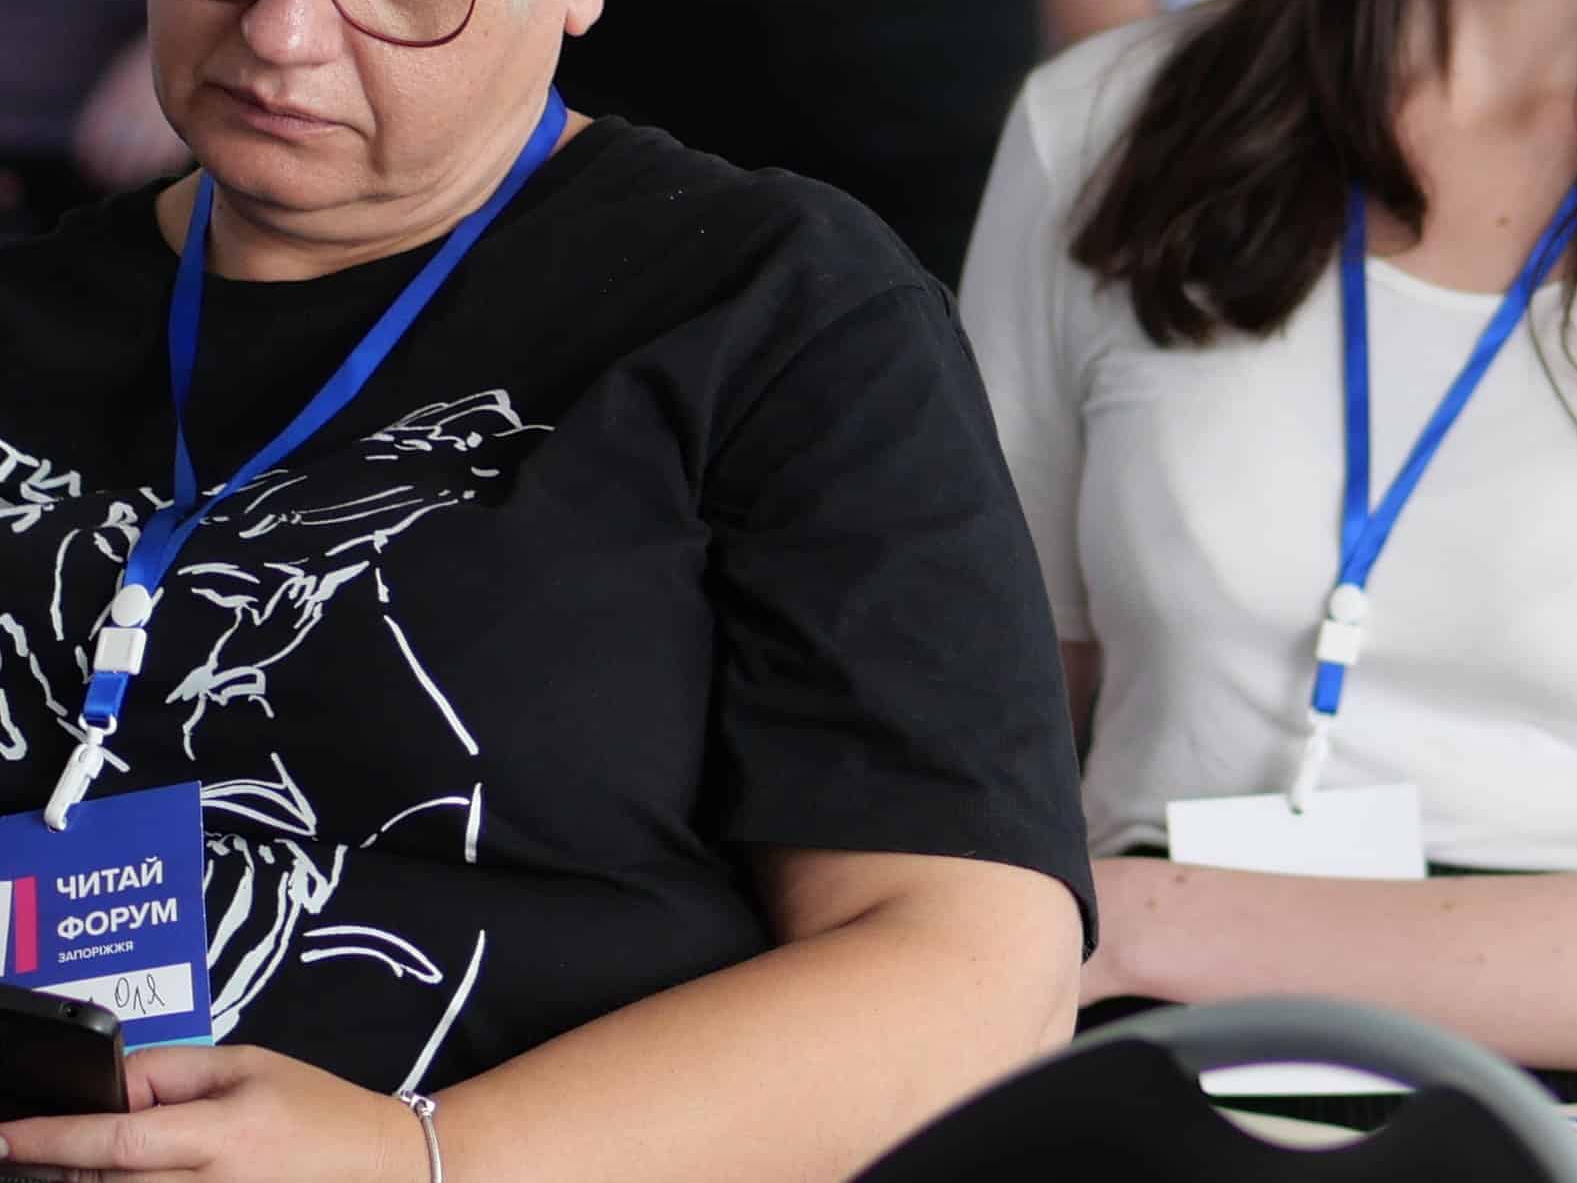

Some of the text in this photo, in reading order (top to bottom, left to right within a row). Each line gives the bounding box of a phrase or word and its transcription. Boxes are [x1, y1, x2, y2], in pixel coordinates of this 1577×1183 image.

[56, 856, 163, 900] ЧИТАЙ
[57, 898, 178, 939] ФОРУМ
[58, 940, 134, 963] ЗАПОРІЖЖЯ
